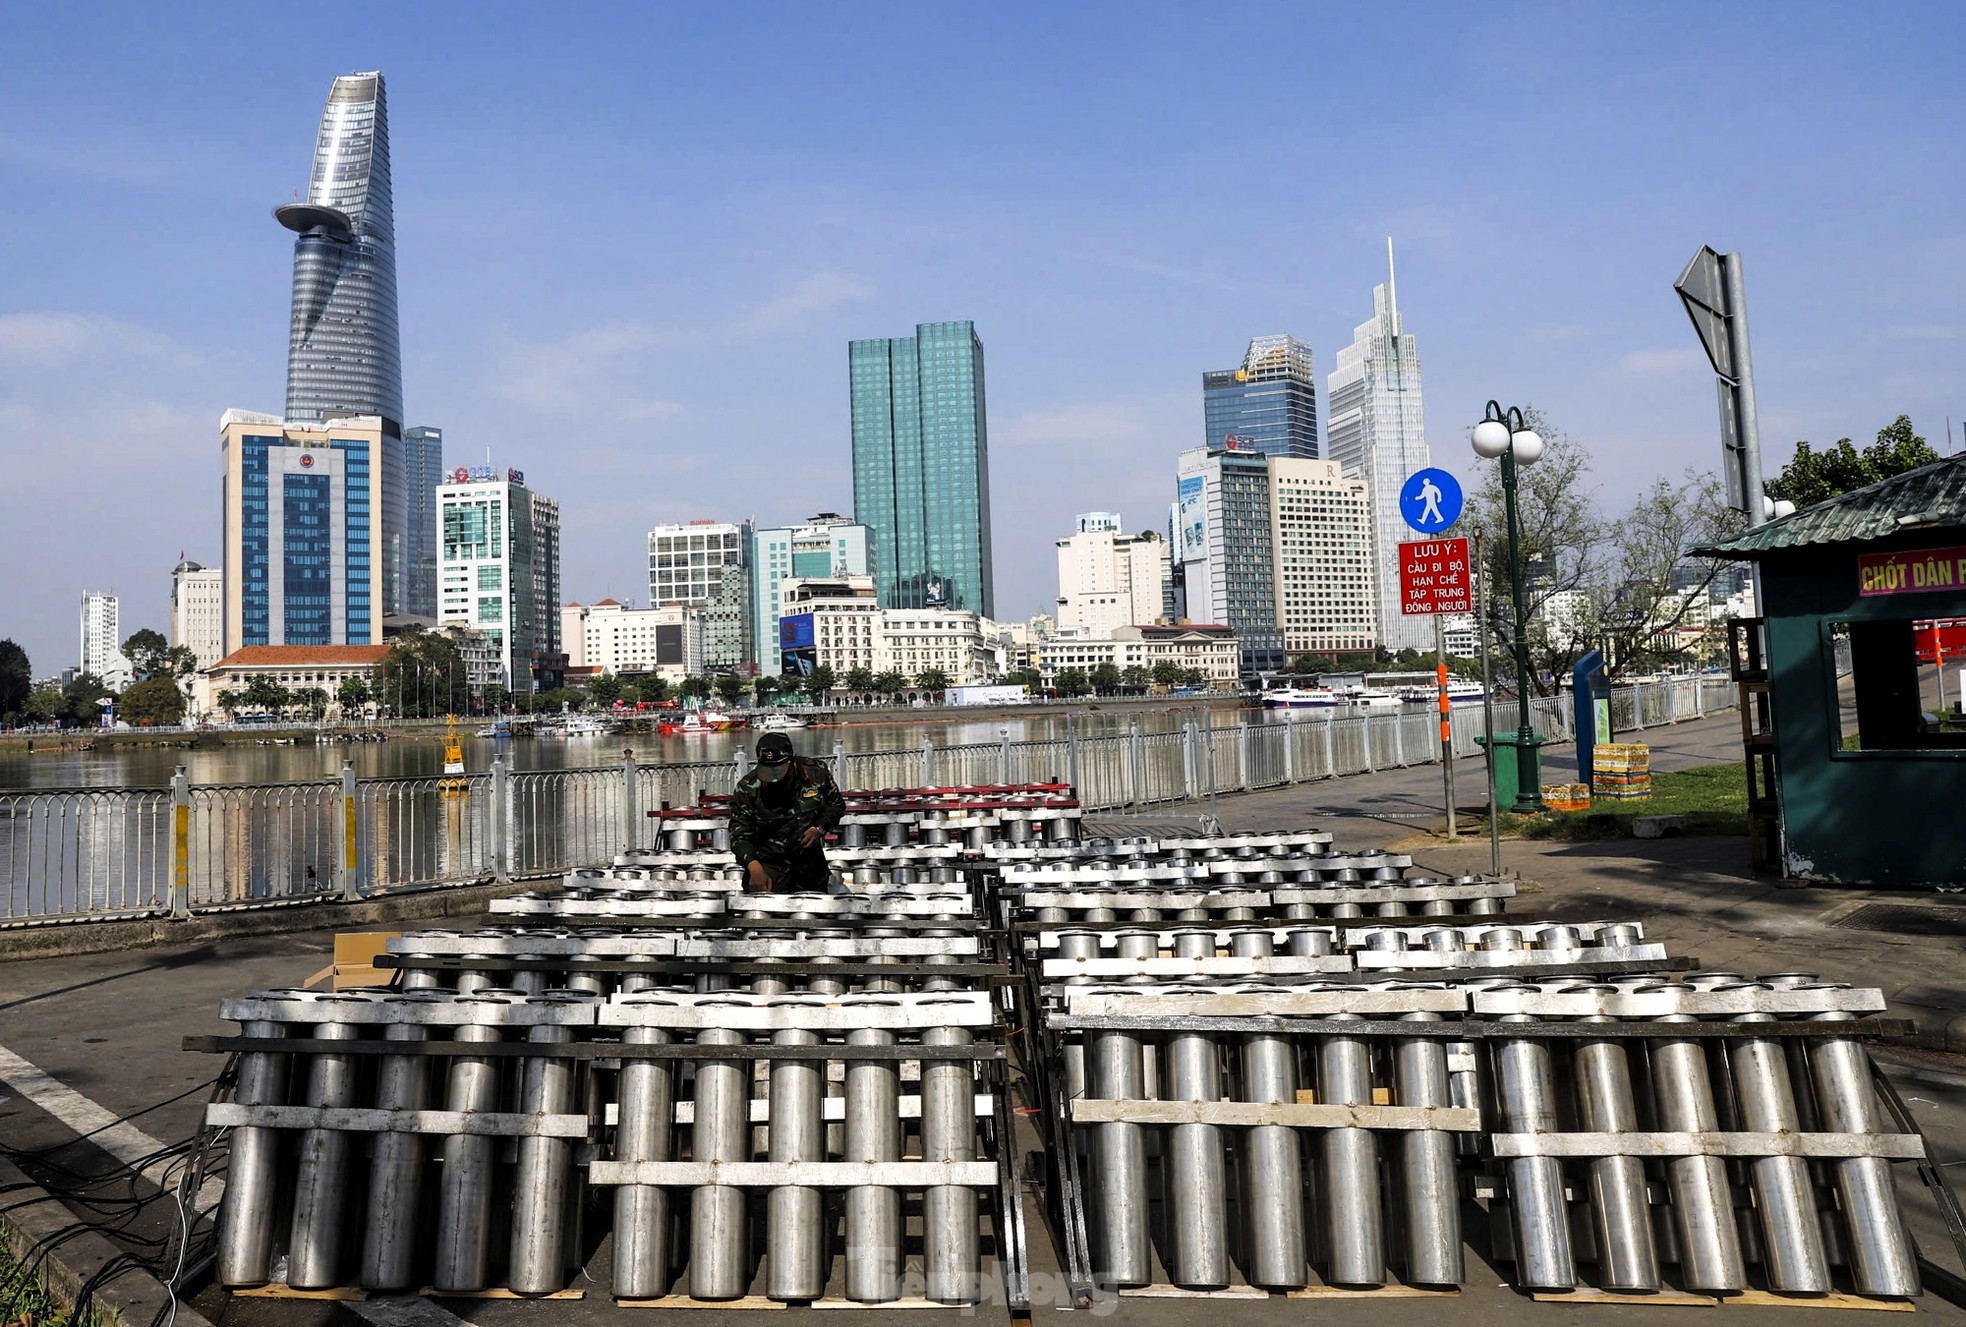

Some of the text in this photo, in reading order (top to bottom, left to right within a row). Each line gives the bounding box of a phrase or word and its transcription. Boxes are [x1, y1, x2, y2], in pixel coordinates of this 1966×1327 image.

[1327, 464, 1335, 477] R
[1413, 543, 1440, 558] LƯU
[1407, 560, 1427, 574] CẦU
[1432, 562, 1442, 572] ĐI
[1861, 556, 1907, 592] CHỐT
[1912, 556, 1953, 588] DÂN
[1412, 570, 1459, 588] HẠN CHẾ
[1408, 587, 1465, 601] TẬP TRUNG
[1405, 601, 1432, 613] ĐÔNG
